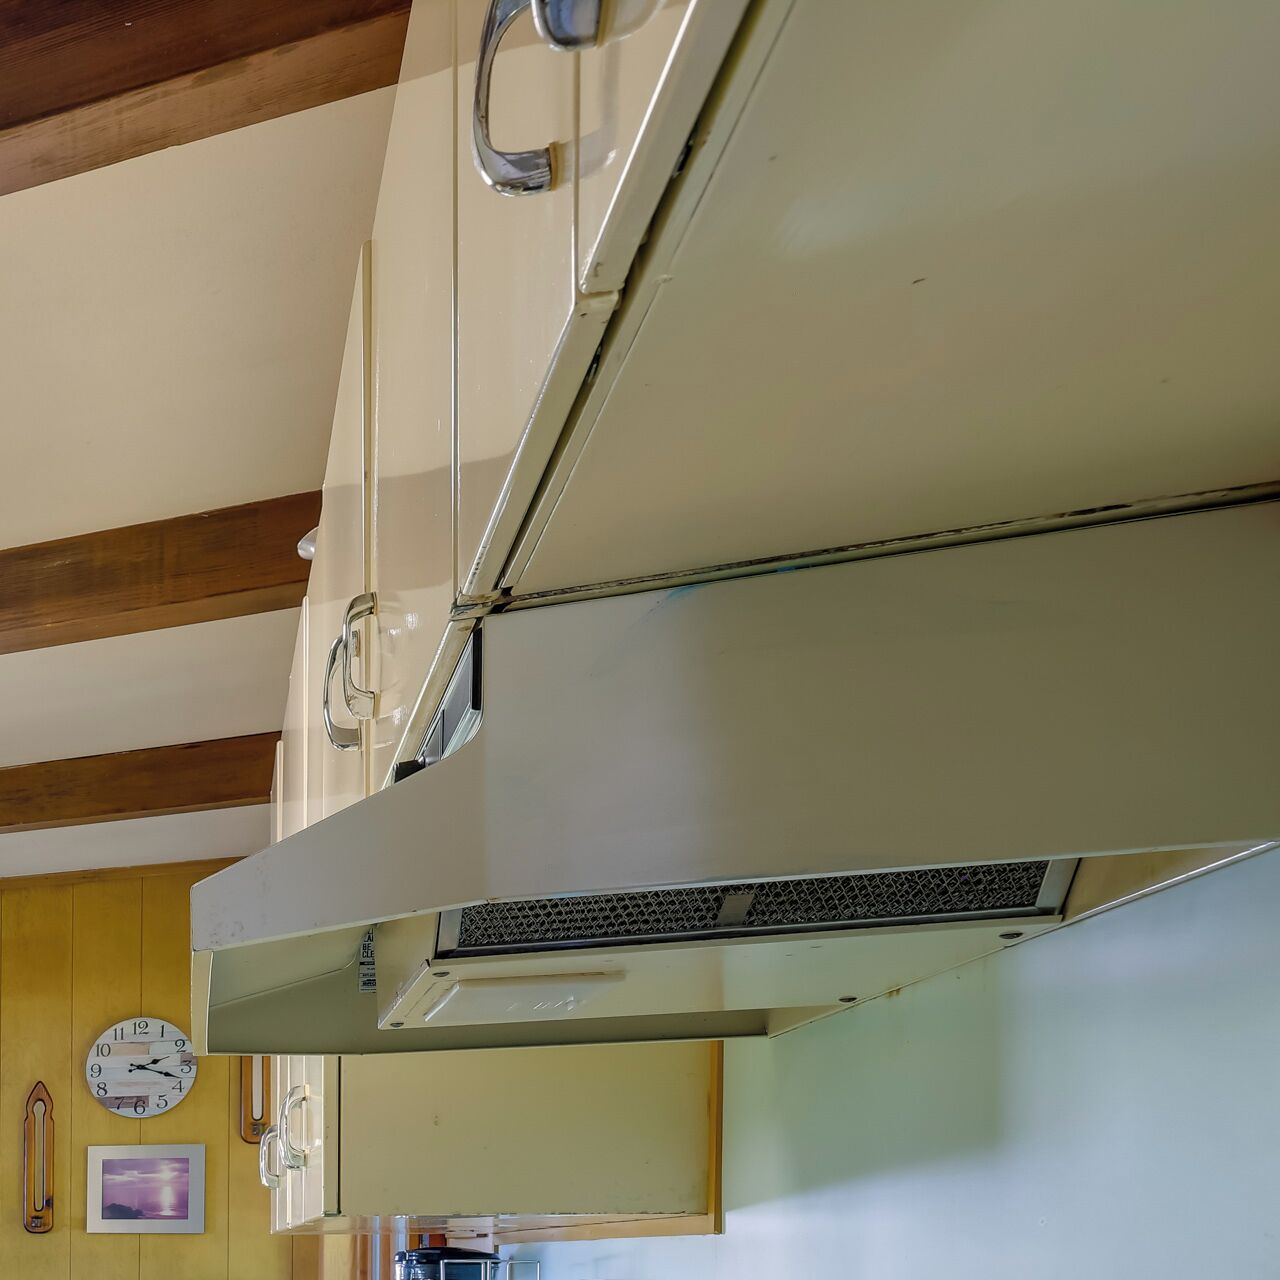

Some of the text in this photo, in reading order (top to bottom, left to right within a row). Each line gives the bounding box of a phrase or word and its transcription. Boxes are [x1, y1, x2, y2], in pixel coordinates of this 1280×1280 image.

[113, 1027, 125, 1041] 11
[133, 1020, 150, 1035] 12
[159, 1024, 166, 1038] 1
[96, 1043, 112, 1057] 10
[175, 1039, 187, 1053] 2
[90, 1064, 102, 1078] 9
[180, 1059, 192, 1074] 3
[96, 1082, 108, 1097] 8
[172, 1080, 185, 1093] 4
[114, 1096, 125, 1110] 7
[133, 1099, 146, 1115] 6
[156, 1094, 168, 1109] 5
